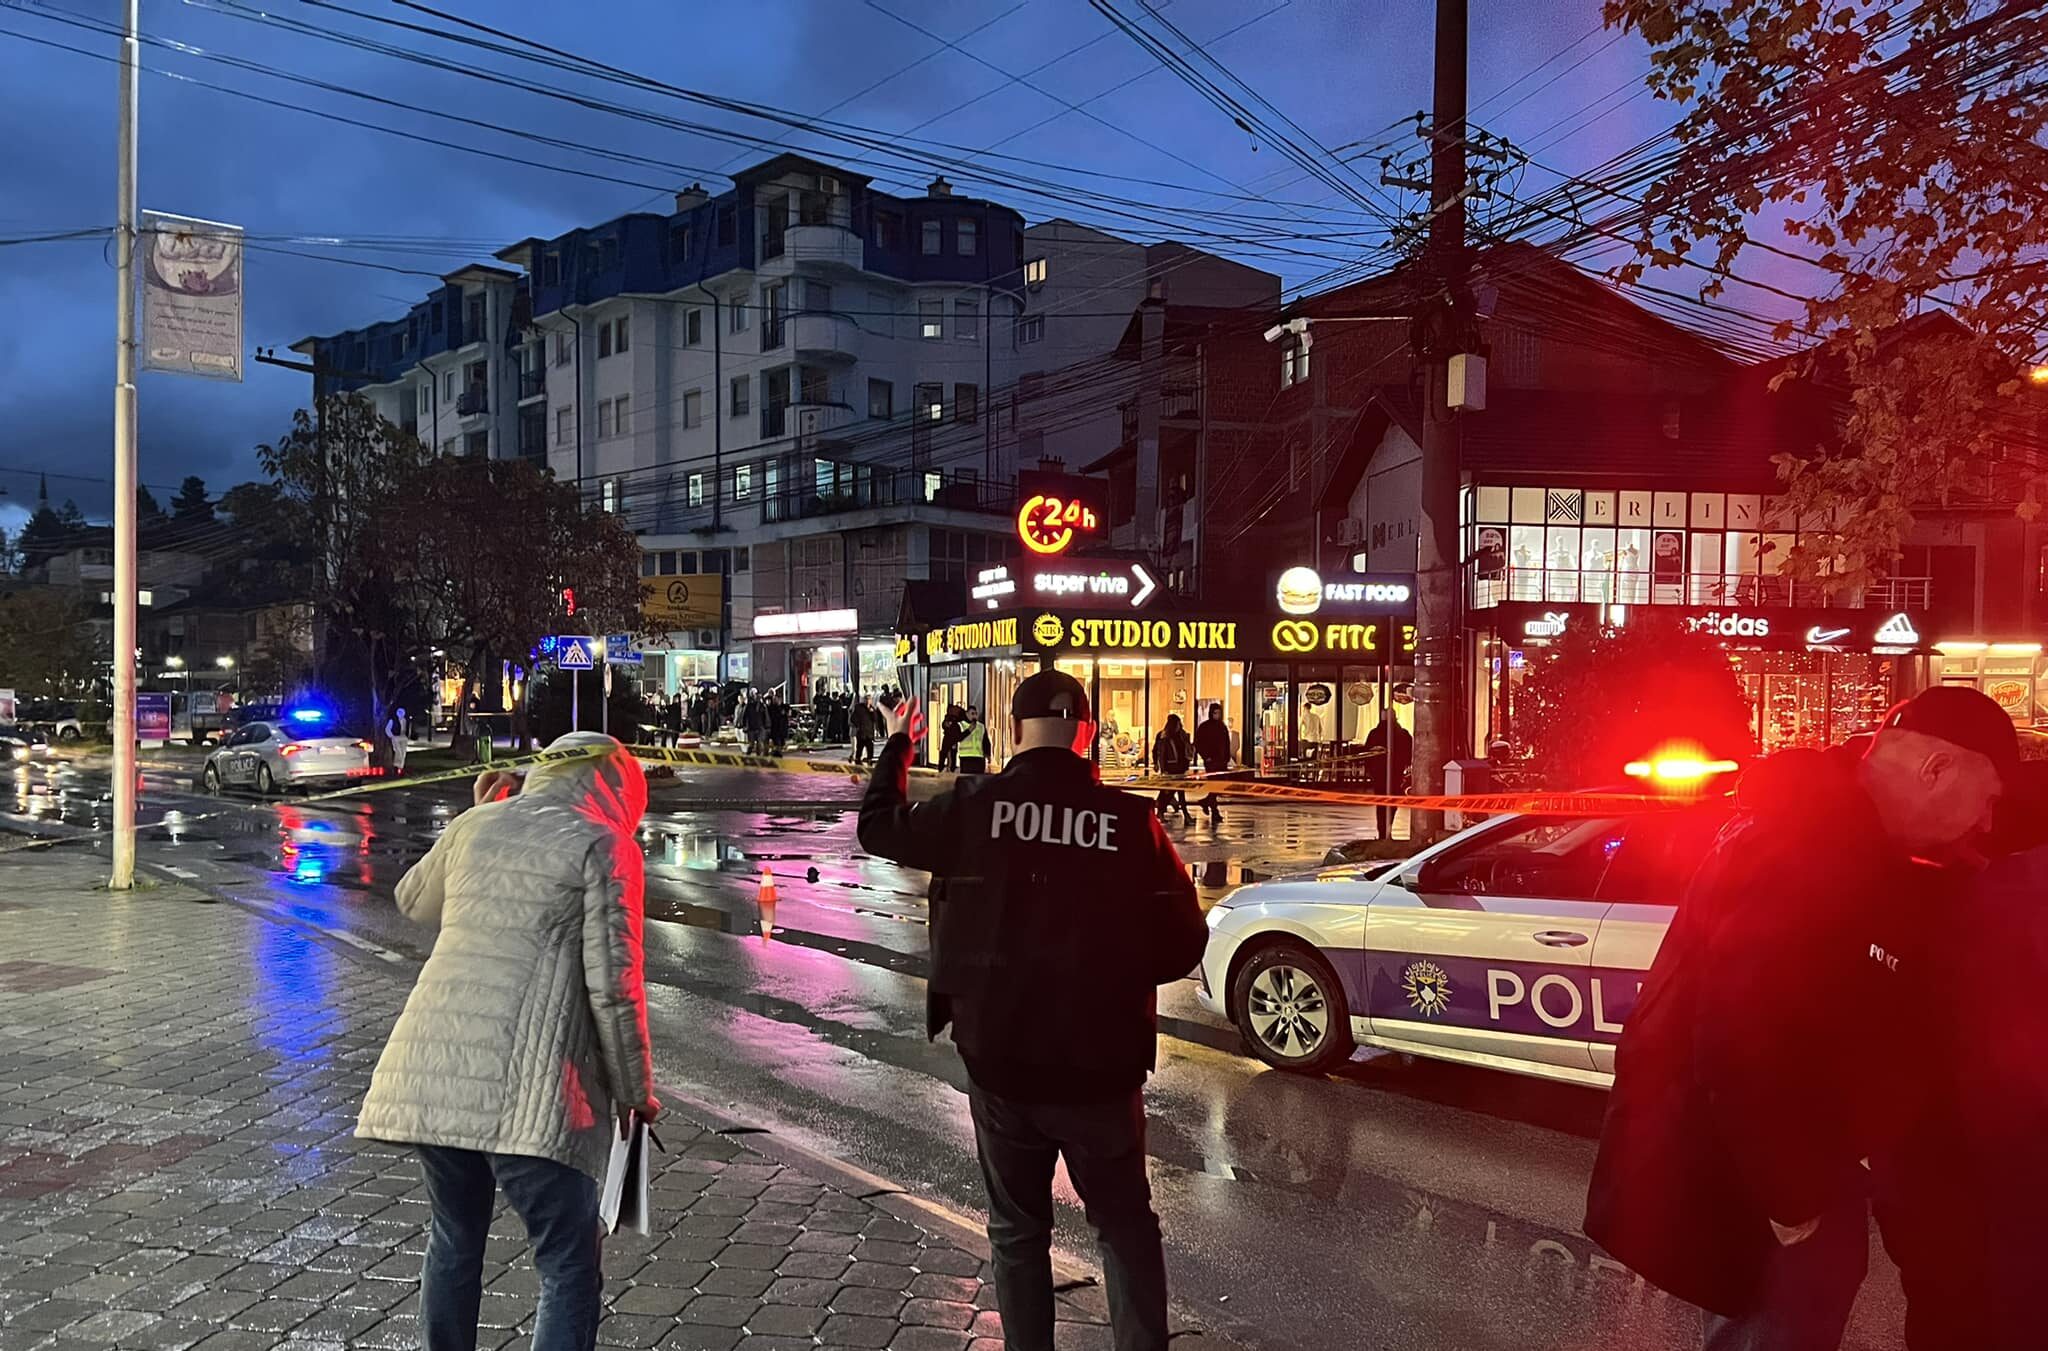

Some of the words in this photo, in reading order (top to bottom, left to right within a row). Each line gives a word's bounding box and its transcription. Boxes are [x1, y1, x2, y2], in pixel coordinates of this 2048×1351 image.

[1043, 497, 1096, 528] 24h
[1034, 573, 1088, 598] super
[1089, 571, 1129, 597] viva
[1325, 584, 1365, 601] FAST
[1366, 584, 1410, 602] FOOD
[954, 622, 992, 651] STUDIO
[992, 617, 1017, 646] NIKI
[1070, 621, 1171, 650] STUDIO
[1178, 621, 1237, 650] NIKI
[991, 800, 1119, 852] POLICE
[1487, 969, 1643, 1034] POL
